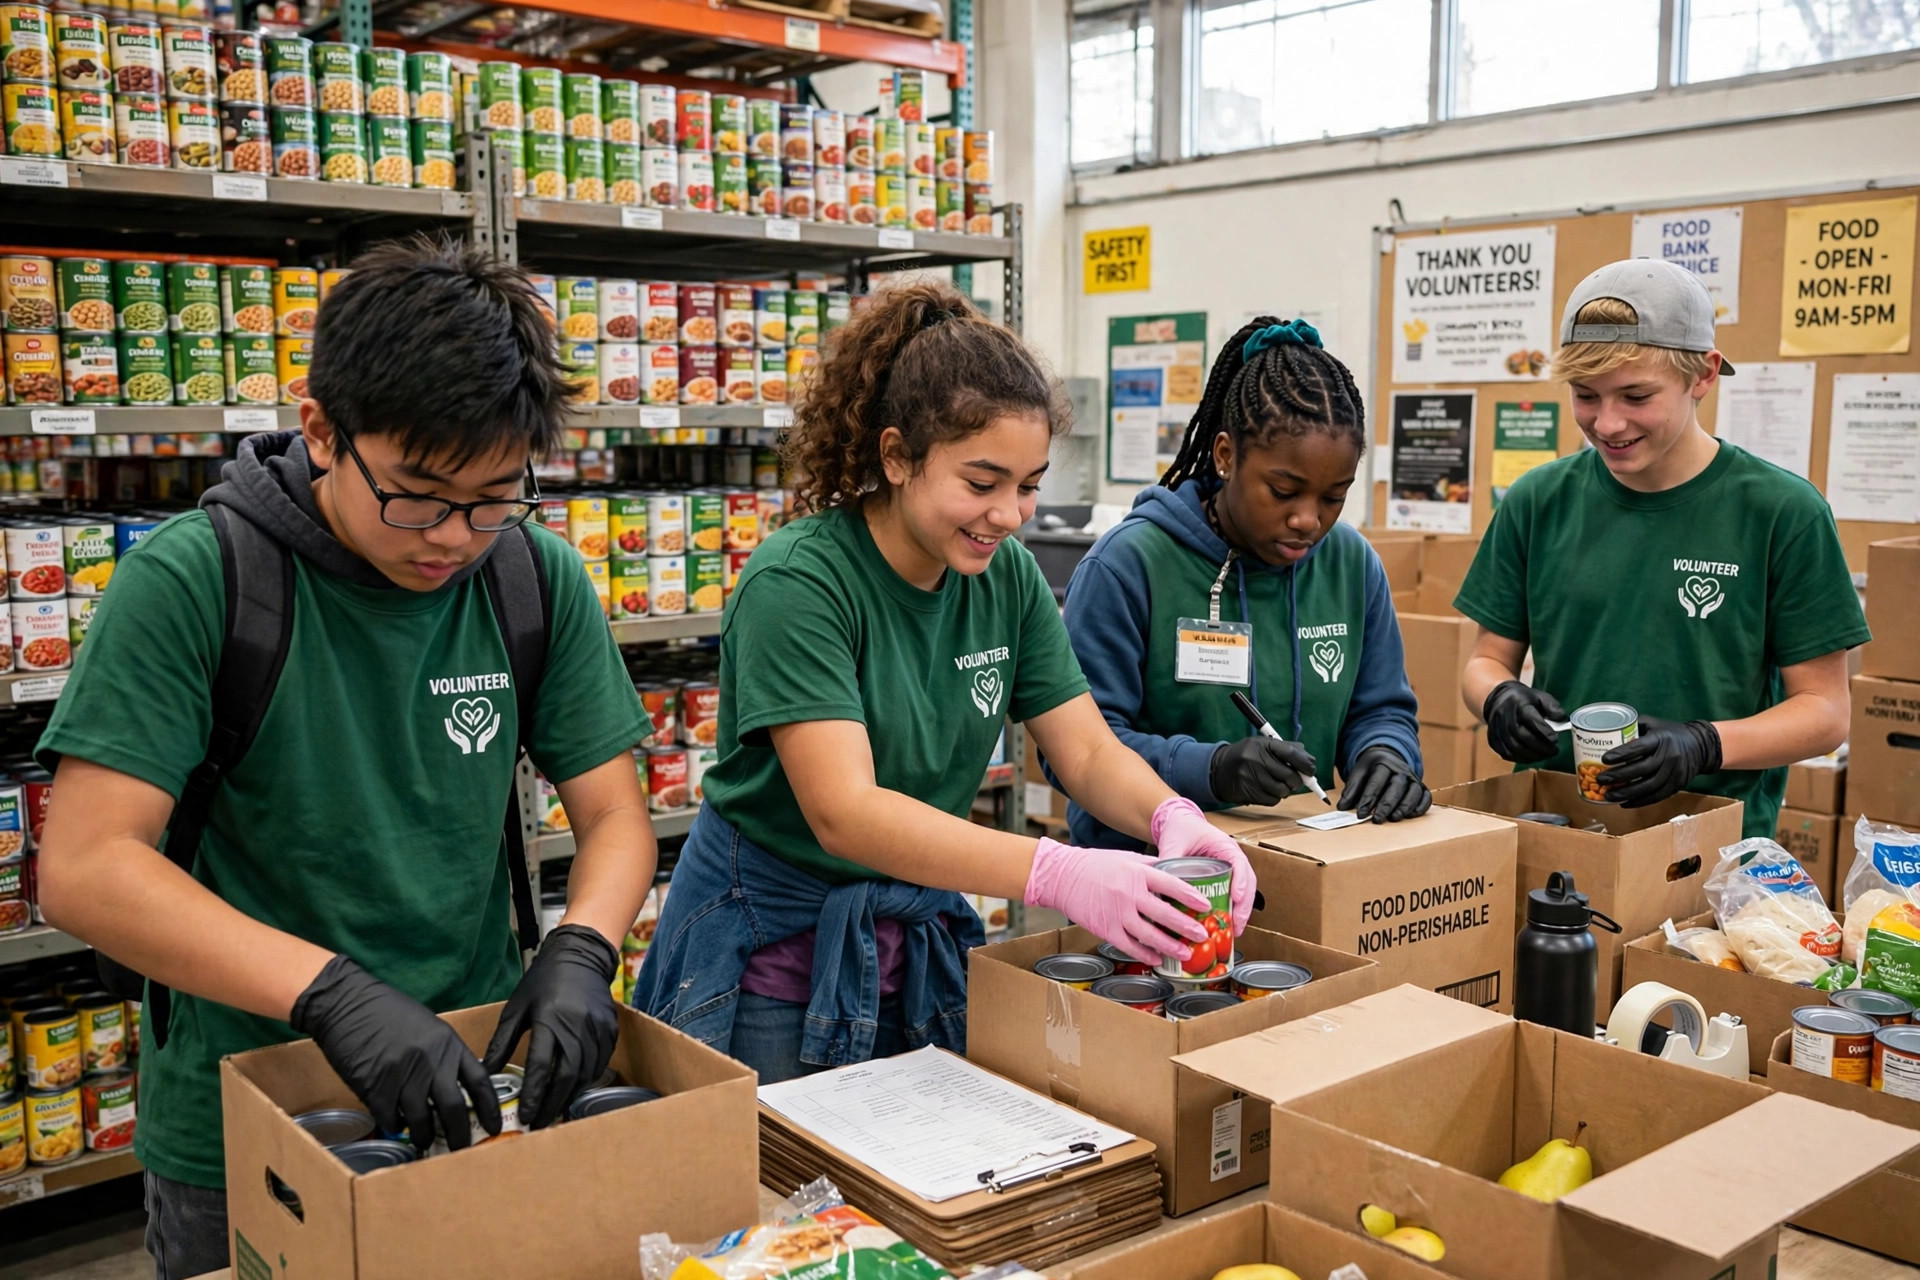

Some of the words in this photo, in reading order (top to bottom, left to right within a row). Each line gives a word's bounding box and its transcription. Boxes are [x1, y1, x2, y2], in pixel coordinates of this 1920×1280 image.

[1662, 219, 1711, 238] FOOD
[1819, 219, 1879, 241] FOOD
[1088, 235, 1145, 260] SAFETY
[1416, 245, 1482, 271] THANK
[1489, 243, 1531, 267] YOU
[1662, 239, 1709, 258] BANK
[1815, 247, 1873, 269] OPEN
[1096, 261, 1138, 283] FIRST
[1406, 269, 1541, 297] VOLUNTEERS!
[1798, 274, 1891, 299] MON-FRI
[1795, 303, 1895, 328] 9AM-5PM
[1673, 558, 1739, 577] VOLUNTEER
[429, 672, 510, 695] VOLUNTEER
[1361, 894, 1406, 924] FOOD
[1409, 875, 1485, 912] DONATION
[1358, 903, 1490, 956] NON-PERISHABLE
